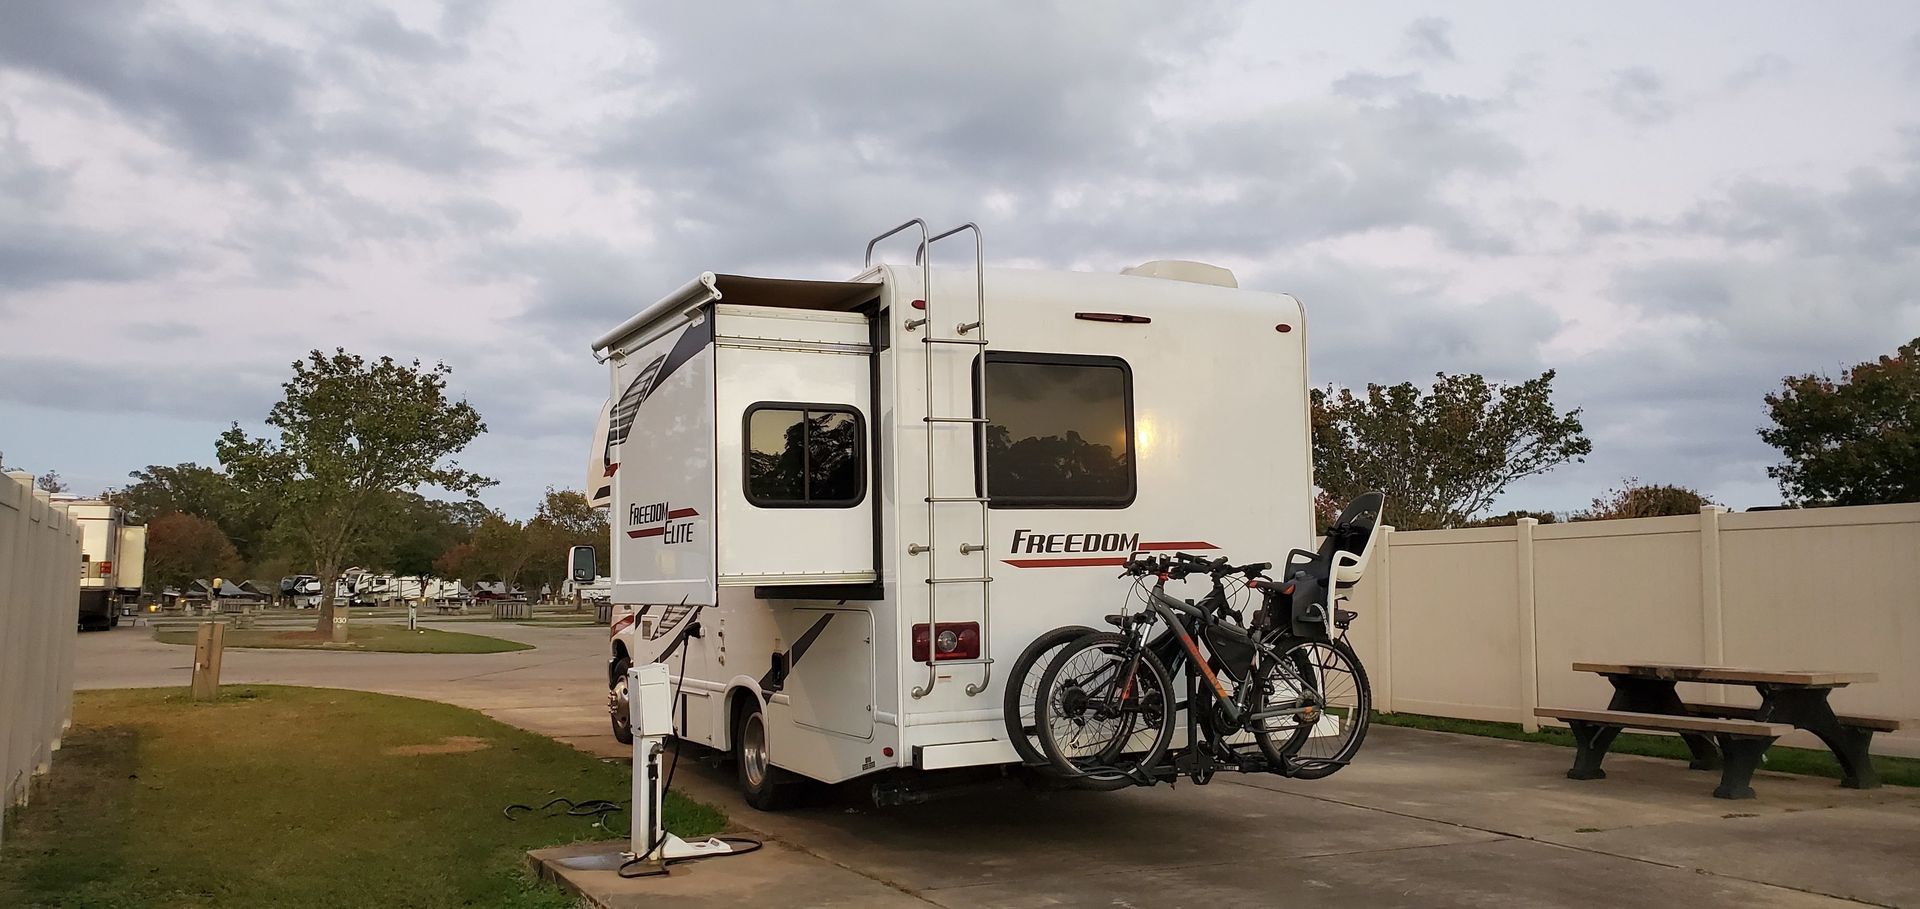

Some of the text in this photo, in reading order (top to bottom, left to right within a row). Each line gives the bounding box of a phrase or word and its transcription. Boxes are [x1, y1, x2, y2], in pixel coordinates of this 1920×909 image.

[629, 501, 669, 526] FREEDOM
[664, 520, 695, 545] ELITE
[1010, 529, 1140, 554] FREEDOM
